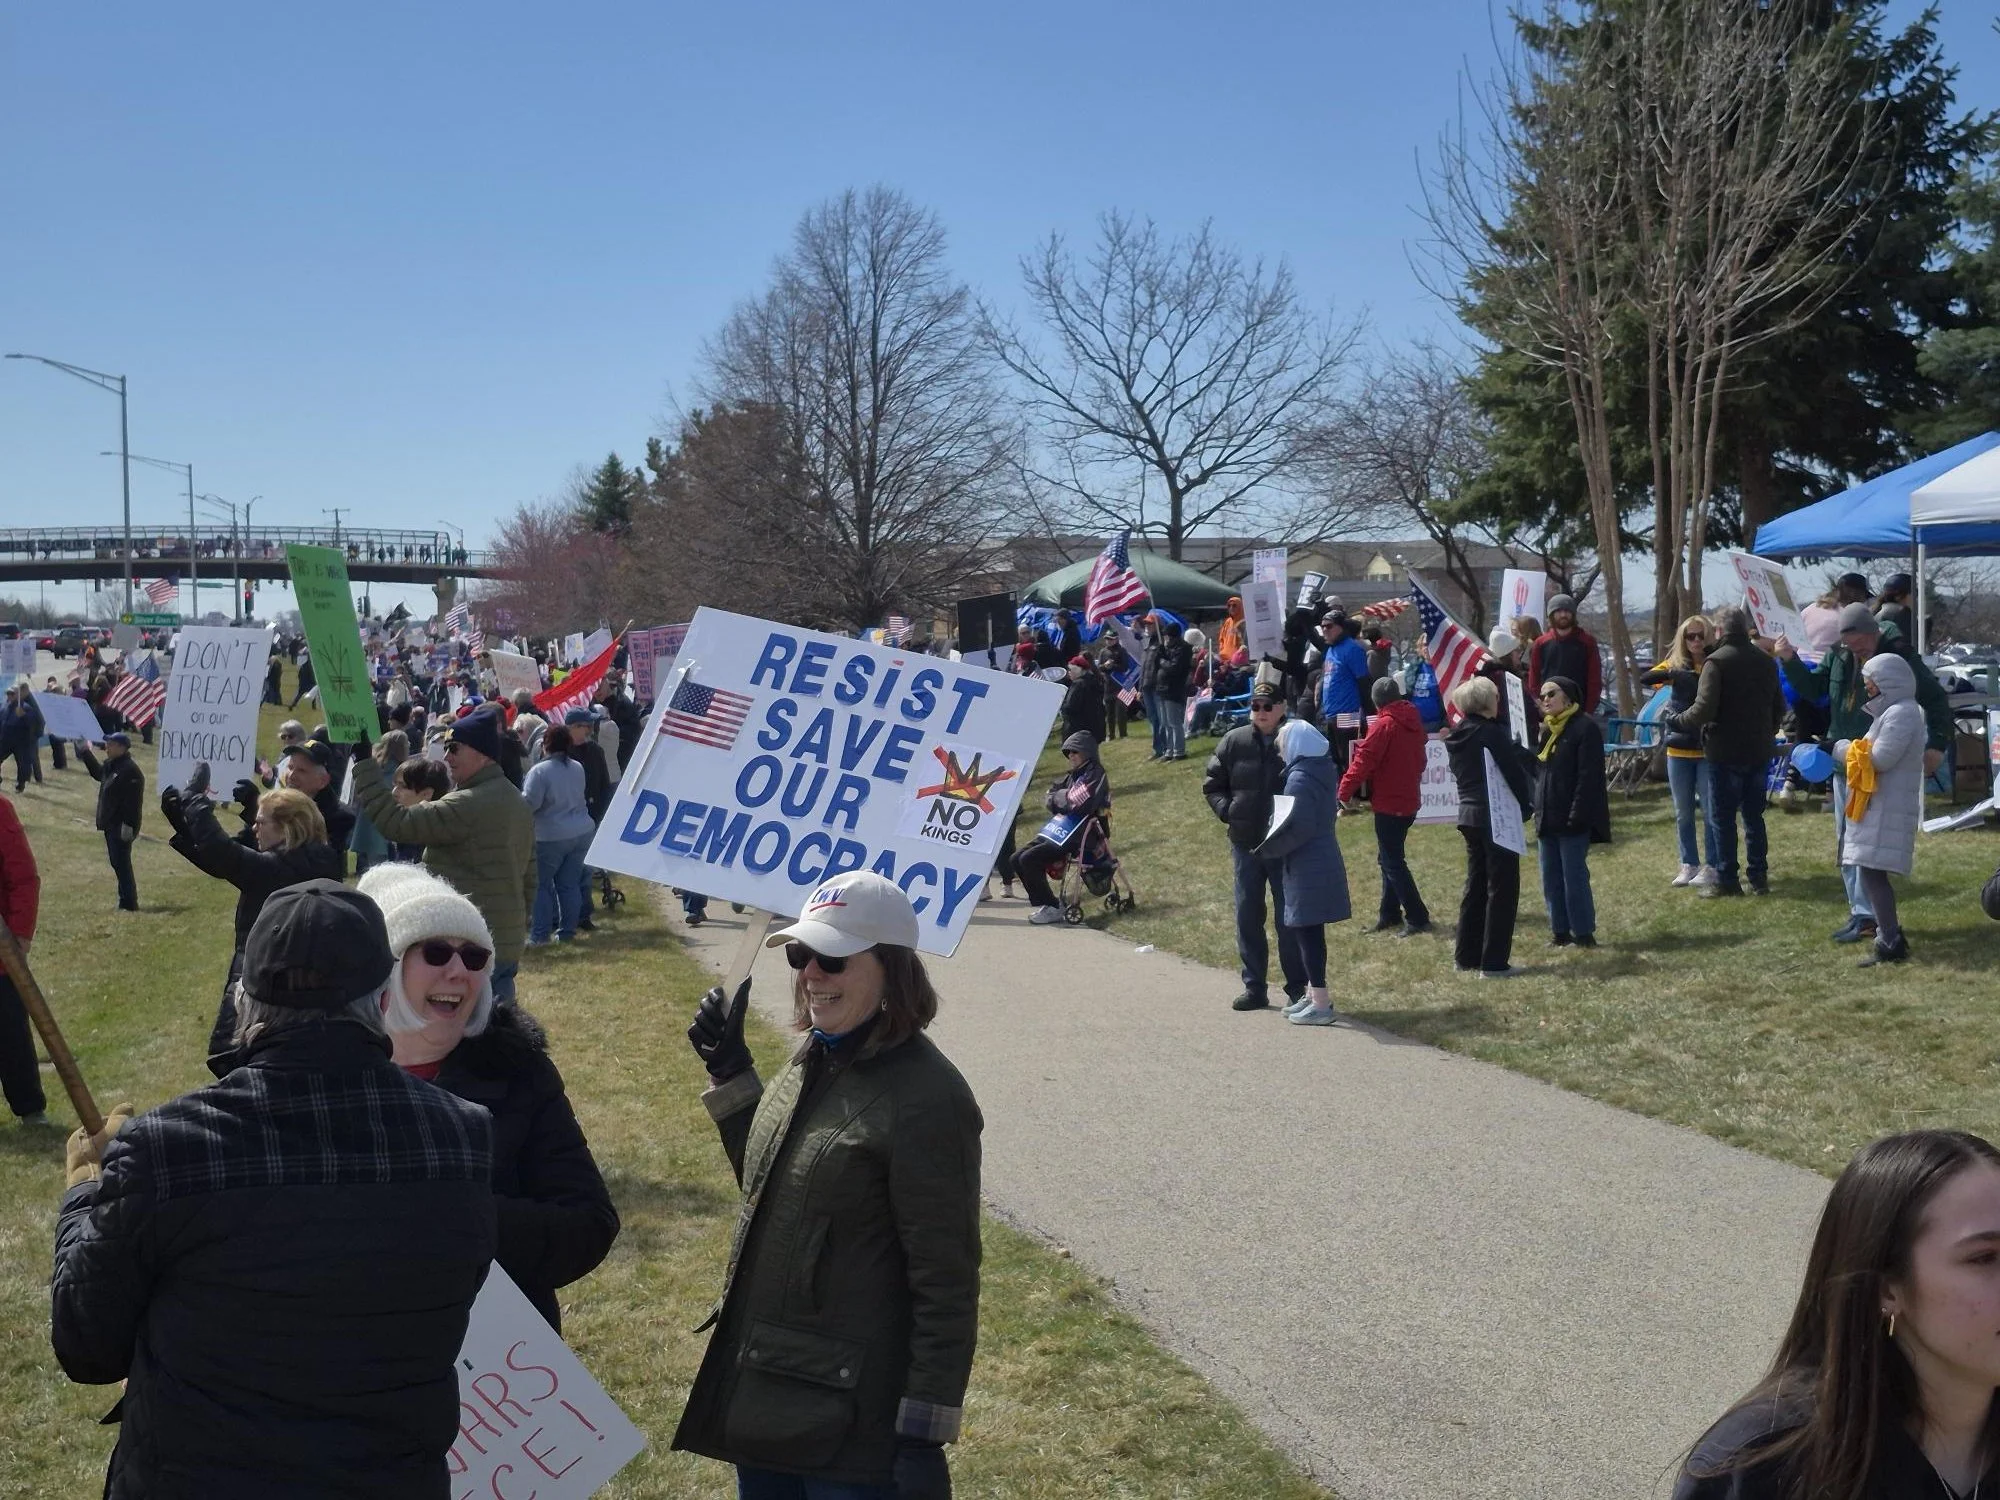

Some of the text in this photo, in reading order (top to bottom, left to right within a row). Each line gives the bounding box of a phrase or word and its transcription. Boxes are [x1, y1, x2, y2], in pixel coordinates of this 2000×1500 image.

[184, 640, 258, 670] DON'T
[177, 675, 251, 705] TREAD
[191, 712, 229, 725] on our
[162, 730, 250, 763] DEMOCRACY
[757, 697, 926, 784] SAVE
[735, 754, 871, 832] OUR
[927, 799, 981, 831] NO
[921, 824, 973, 846] KINGS
